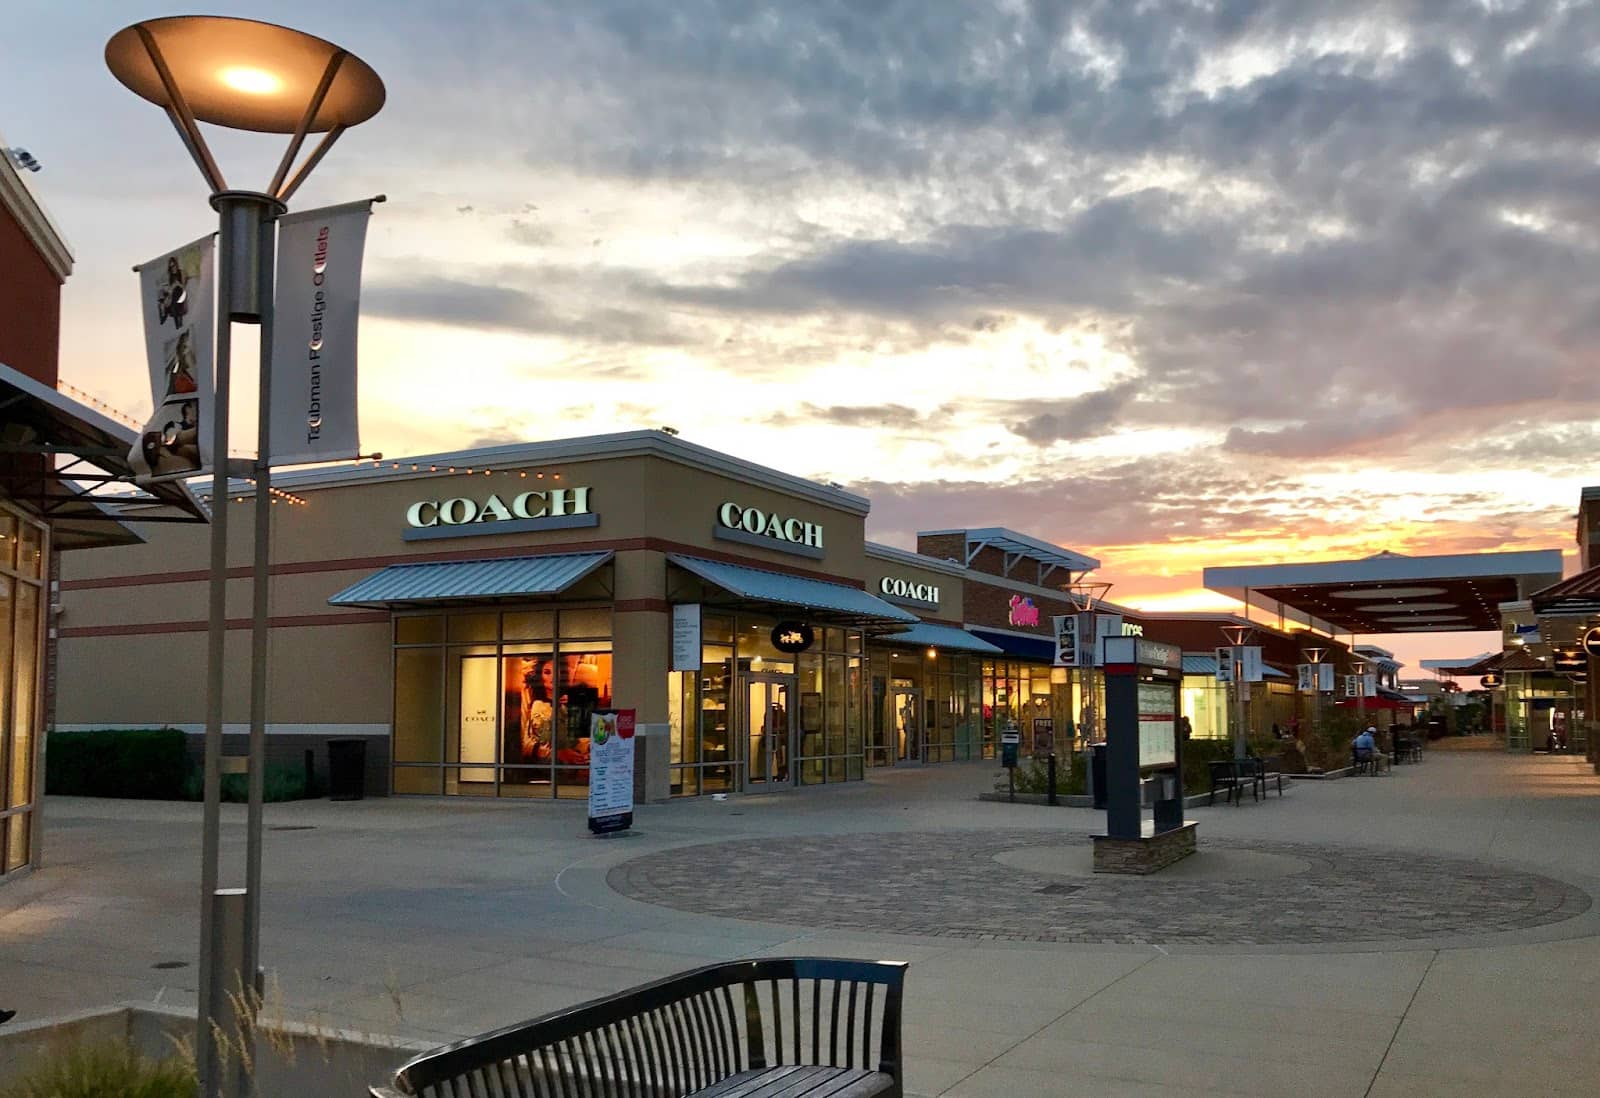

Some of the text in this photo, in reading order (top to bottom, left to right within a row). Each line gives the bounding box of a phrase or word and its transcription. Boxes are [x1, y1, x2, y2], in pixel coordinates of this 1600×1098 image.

[307, 364, 322, 445] Taubman
[406, 486, 591, 528] COACH
[719, 502, 825, 549] COACH
[880, 576, 940, 604] COACH
